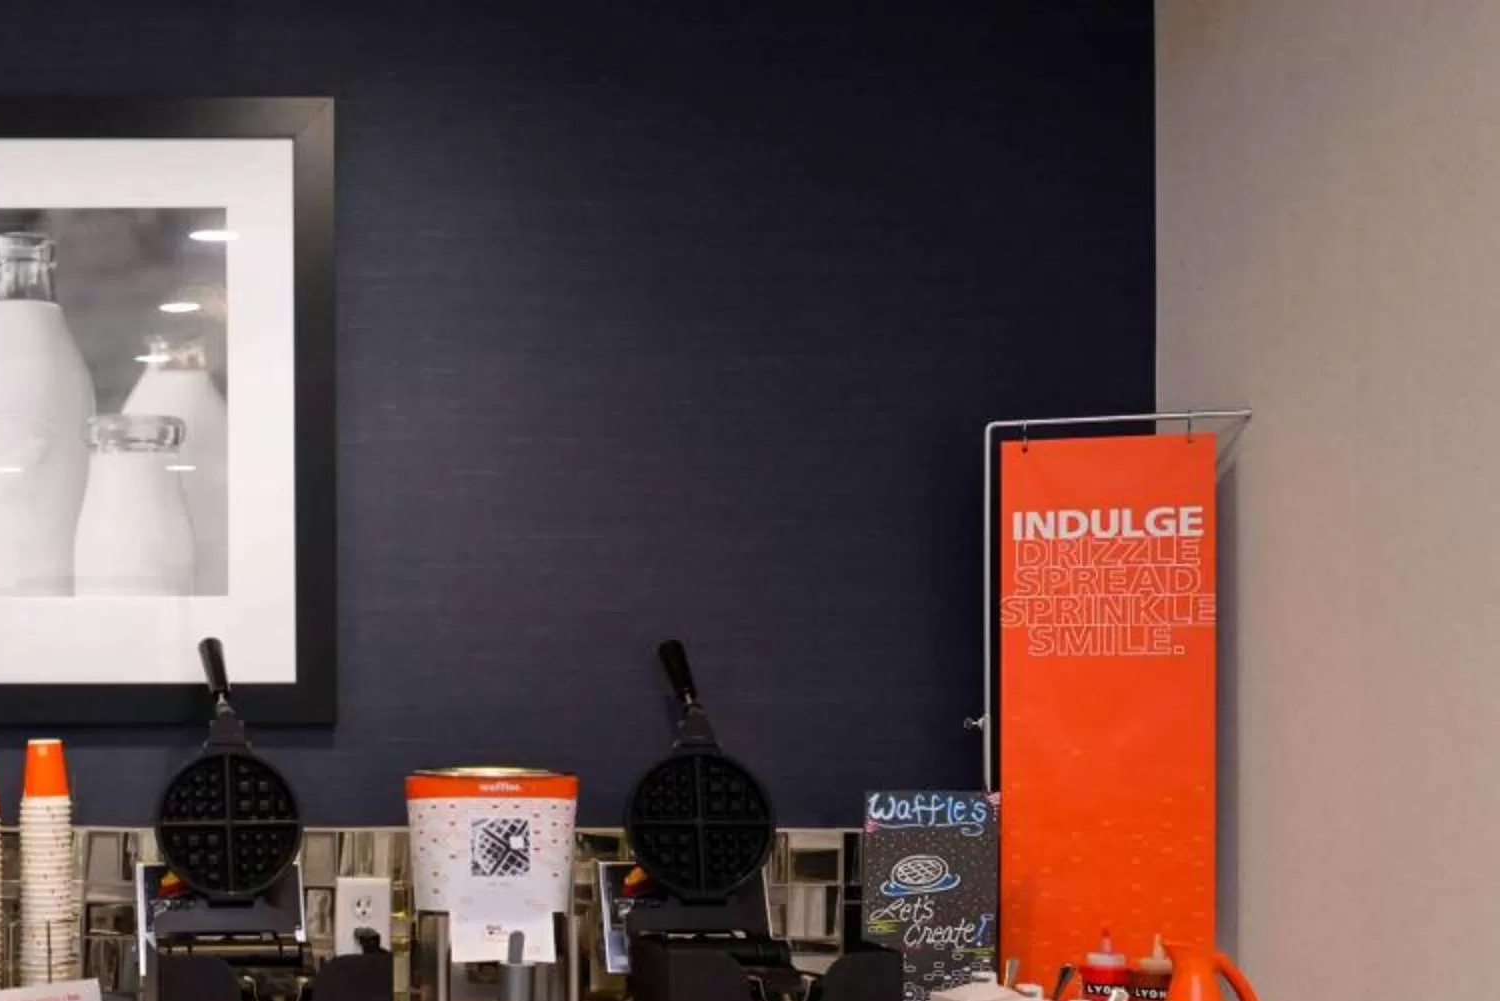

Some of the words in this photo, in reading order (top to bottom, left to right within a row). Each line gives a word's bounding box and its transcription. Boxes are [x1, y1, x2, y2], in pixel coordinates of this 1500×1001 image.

[1012, 506, 1204, 541] INDULGE
[1014, 536, 1202, 568] DRIZZLE
[1013, 564, 1201, 597] SPREAD
[1000, 593, 1217, 627] SPRINKLE
[1028, 622, 1185, 656] SMILE.
[867, 792, 988, 826] Waffle's
[869, 895, 935, 923] Let's
[1086, 984, 1126, 994] LYO
[1135, 986, 1167, 999] LYON
